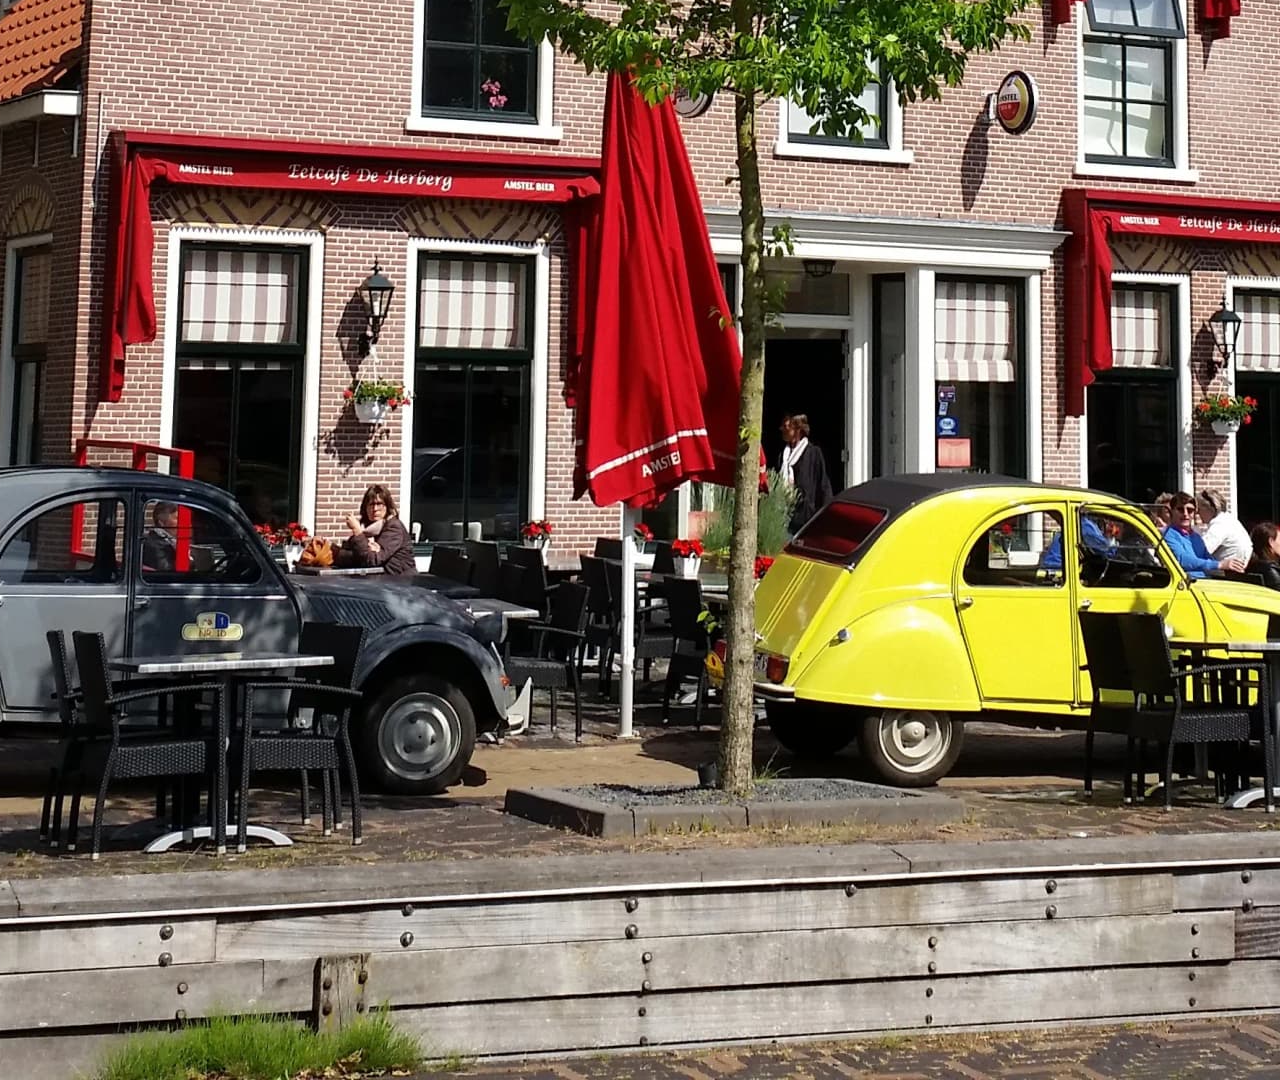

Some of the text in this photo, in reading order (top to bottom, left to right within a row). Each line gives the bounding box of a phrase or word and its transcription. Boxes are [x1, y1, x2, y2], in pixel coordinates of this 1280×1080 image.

[179, 164, 212, 175] AMSTEL
[288, 164, 454, 191] Eetcafé De Herberg
[504, 180, 555, 192] AMSTEL BIER
[1227, 218, 1243, 231] De
